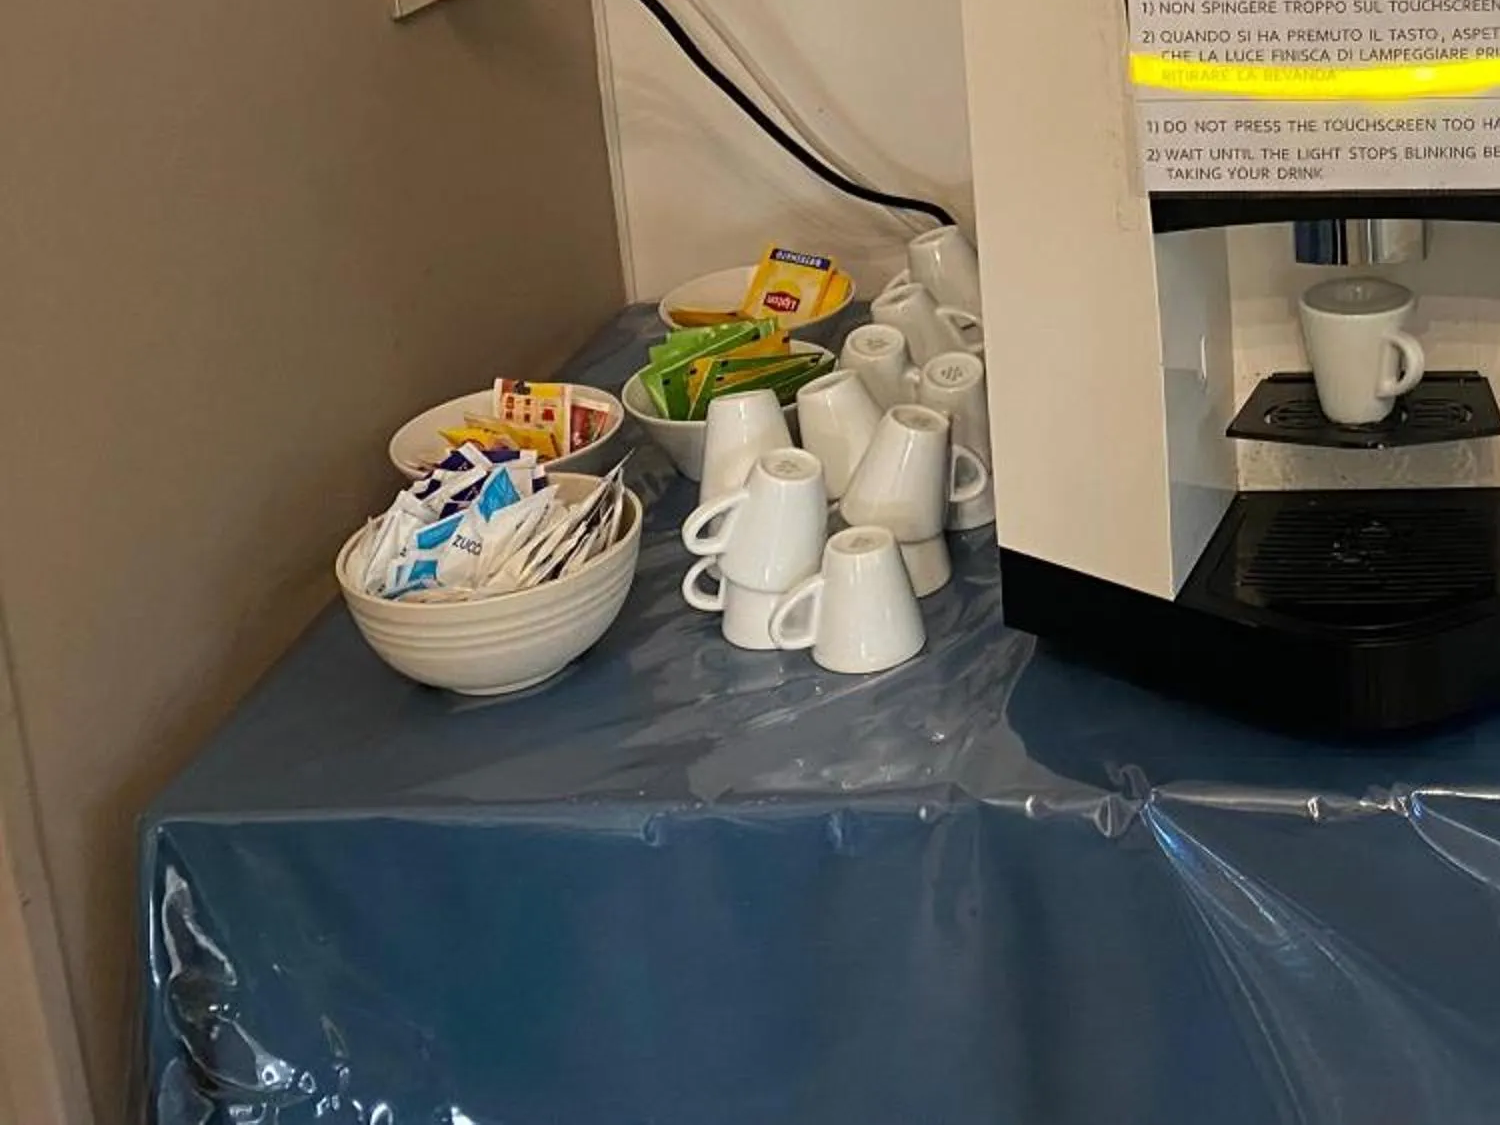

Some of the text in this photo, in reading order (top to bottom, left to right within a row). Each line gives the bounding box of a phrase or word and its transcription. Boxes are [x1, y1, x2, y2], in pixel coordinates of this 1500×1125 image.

[1141, 1, 1154, 17] 1)
[1159, 1, 1195, 15] NON
[1201, 0, 1277, 15] SPINGERE
[1284, 0, 1347, 14] TROPPO
[1353, 0, 1383, 14] SUL
[1142, 30, 1155, 45] 2)
[1160, 30, 1232, 44] QUANDO
[1238, 30, 1250, 43] SI
[1257, 30, 1281, 43] HA
[1287, 28, 1363, 43] PREMUTO
[1369, 29, 1382, 42] IL
[1161, 49, 1194, 62] CHE
[1200, 49, 1220, 62] LA
[1225, 49, 1265, 62] LUCE
[1271, 48, 1331, 62] FINISCA
[1337, 48, 1353, 62] DI
[1359, 47, 1469, 62] LAMPEGGIARE
[1163, 120, 1188, 133] DO
[1195, 120, 1227, 133] NOT
[1235, 119, 1281, 133] PRESS
[1287, 119, 1319, 133] THE
[1323, 118, 1437, 133] TOUCHSCREEN
[1442, 118, 1476, 132] TOO
[1147, 148, 1160, 162] 2)
[1165, 148, 1204, 162] WAIT
[1209, 148, 1255, 161] UNTIL
[1260, 148, 1290, 161] THE
[1297, 147, 1341, 161] LIGHT
[1348, 146, 1398, 160] STOPS
[1405, 146, 1477, 160] BLINKING
[1167, 166, 1324, 180] TAKING YOUR DRINK
